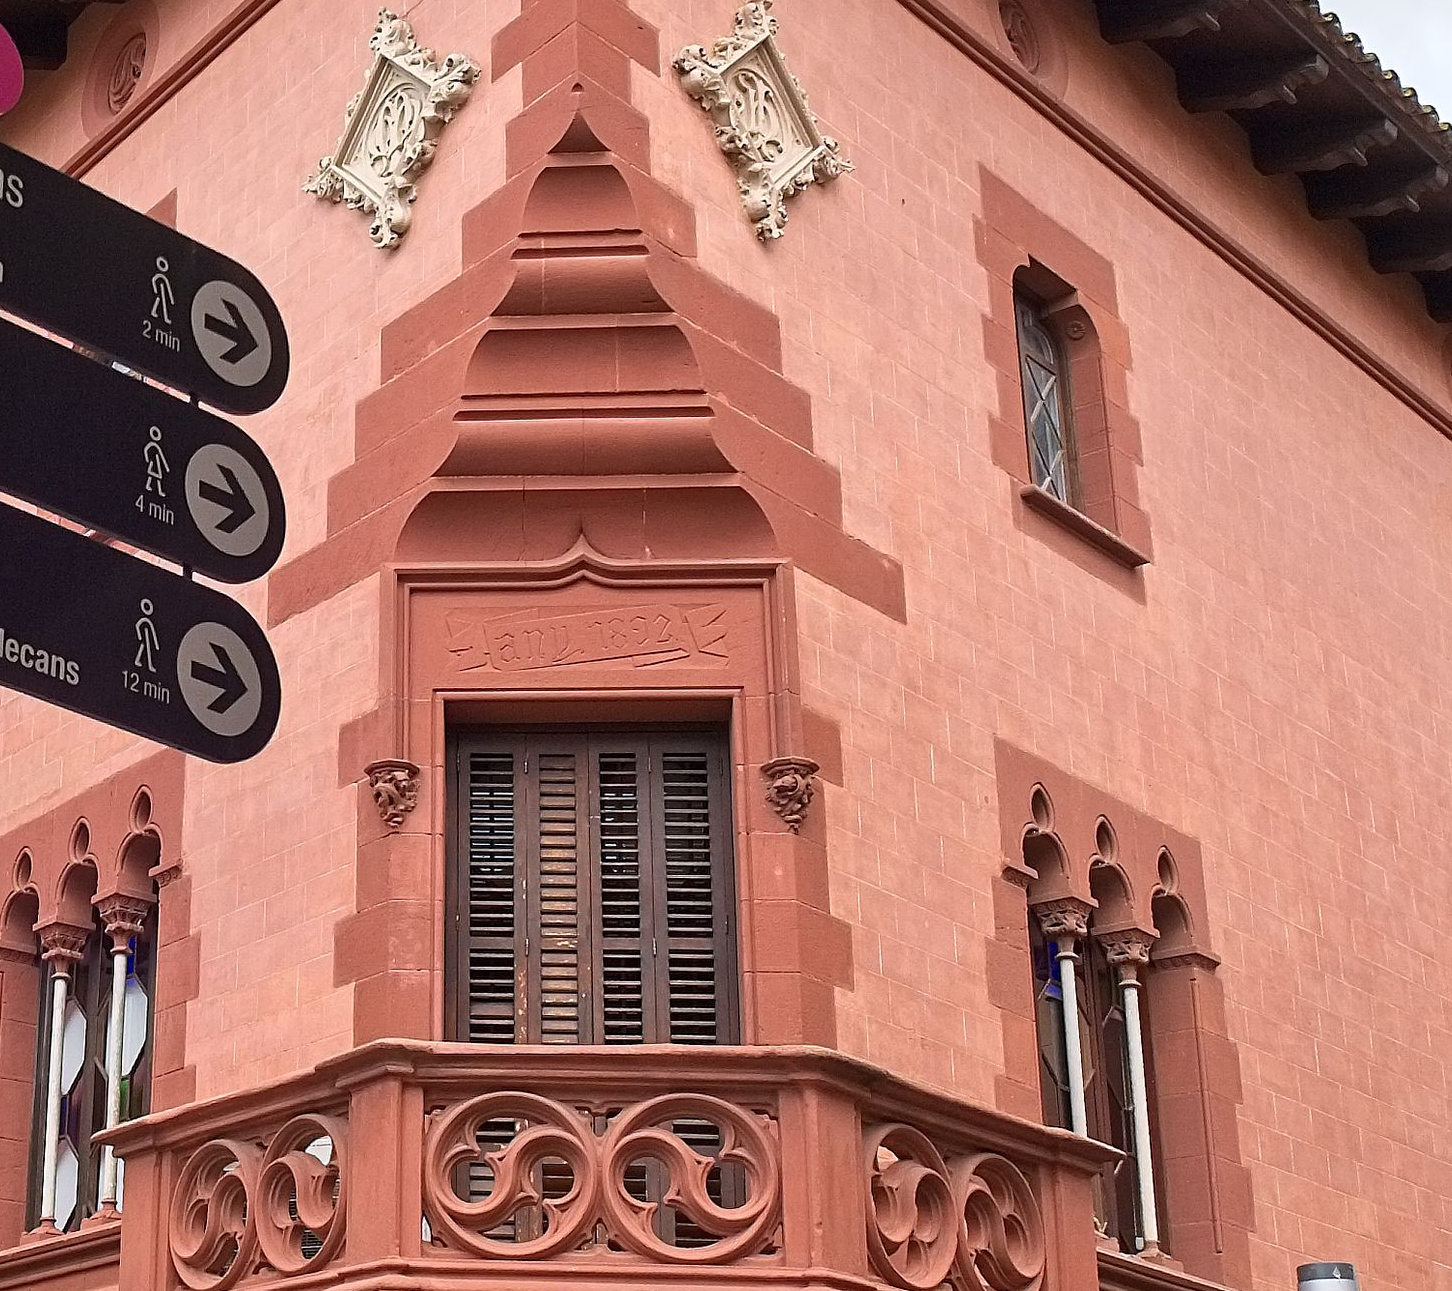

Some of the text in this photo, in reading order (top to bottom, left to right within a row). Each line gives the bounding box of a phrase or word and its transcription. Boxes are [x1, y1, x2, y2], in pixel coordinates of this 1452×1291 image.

[143, 320, 180, 351] 2 min
[136, 495, 174, 525] 4 min
[123, 670, 169, 704] 12 min
